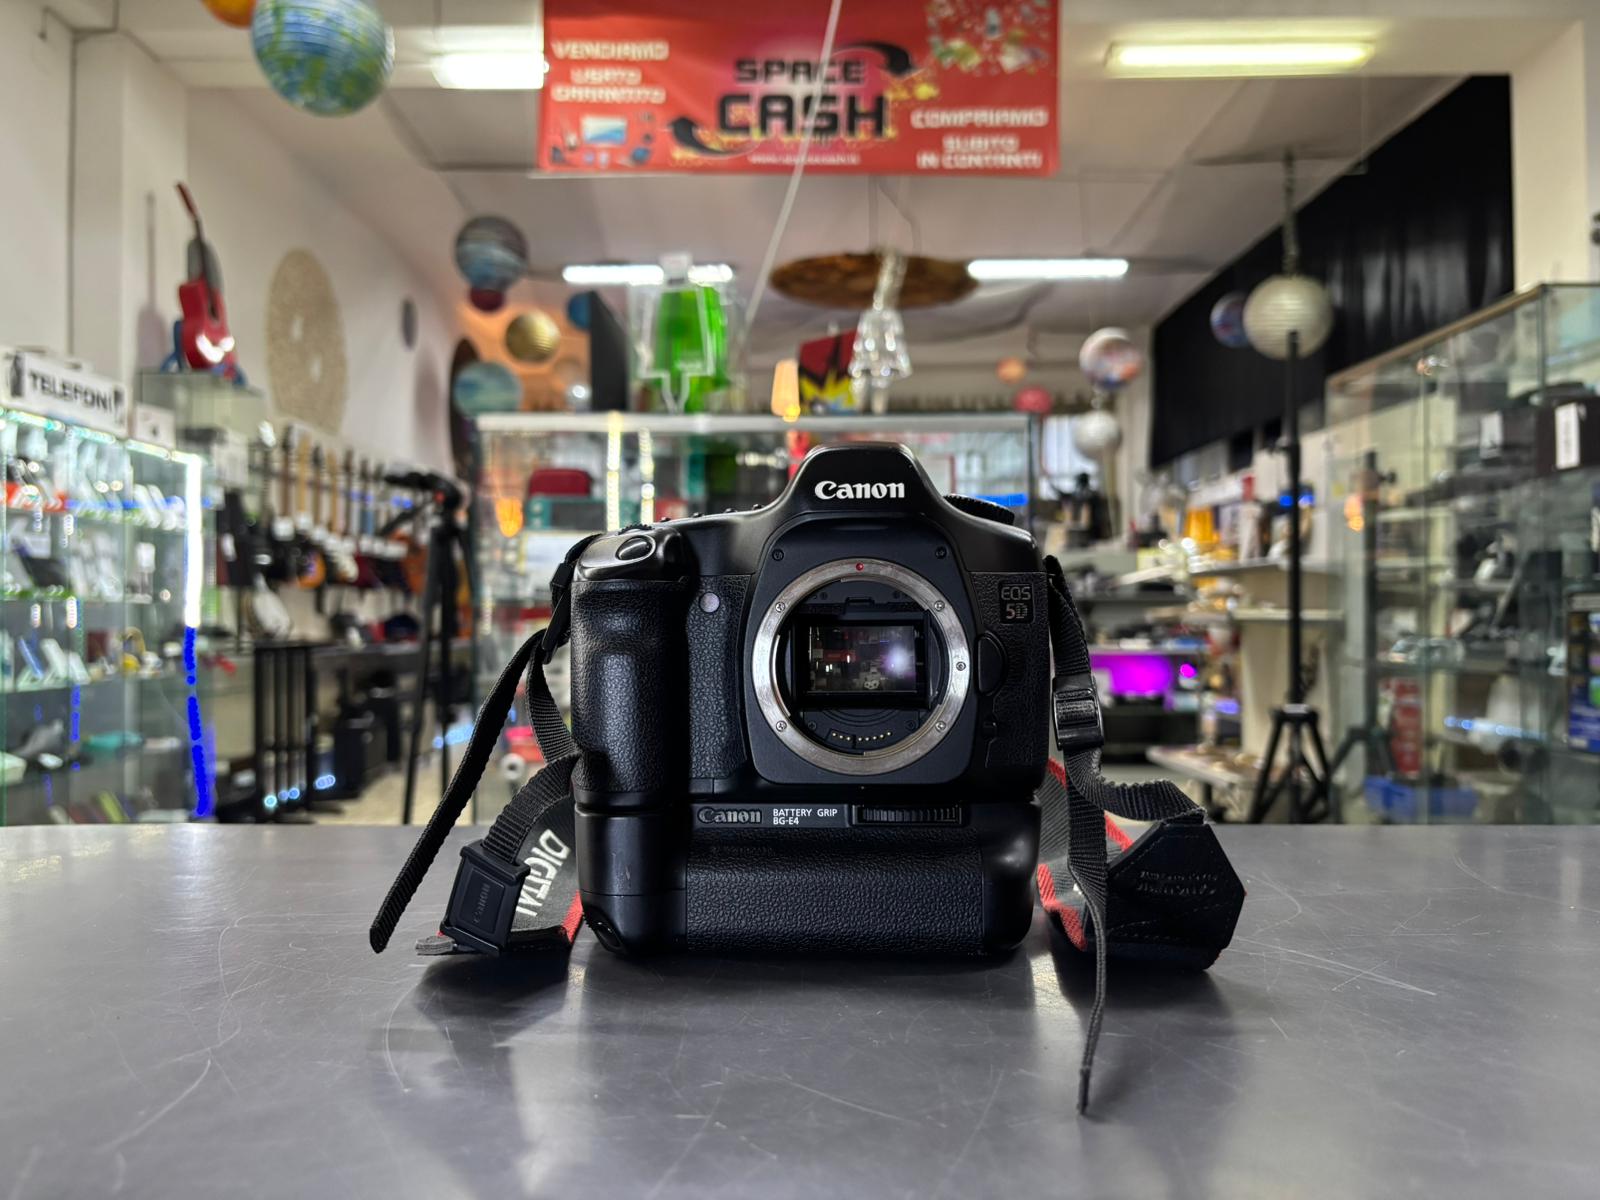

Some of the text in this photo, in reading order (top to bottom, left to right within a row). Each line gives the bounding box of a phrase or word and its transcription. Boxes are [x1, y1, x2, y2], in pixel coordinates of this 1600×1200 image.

[551, 40, 669, 60] VENDIAMO
[735, 60, 864, 82] SPACE
[717, 94, 887, 137] CASH
[910, 108, 1049, 128] COMPRIAMO
[942, 135, 1020, 152] SUBITO
[29, 371, 113, 412] TELEFONI
[814, 480, 905, 500] Canon
[1001, 586, 1031, 601] EOS
[1005, 603, 1029, 620] 5D
[698, 806, 763, 824] Canon
[773, 808, 838, 817] BATTERY GRIP
[773, 816, 800, 825] BG-E4
